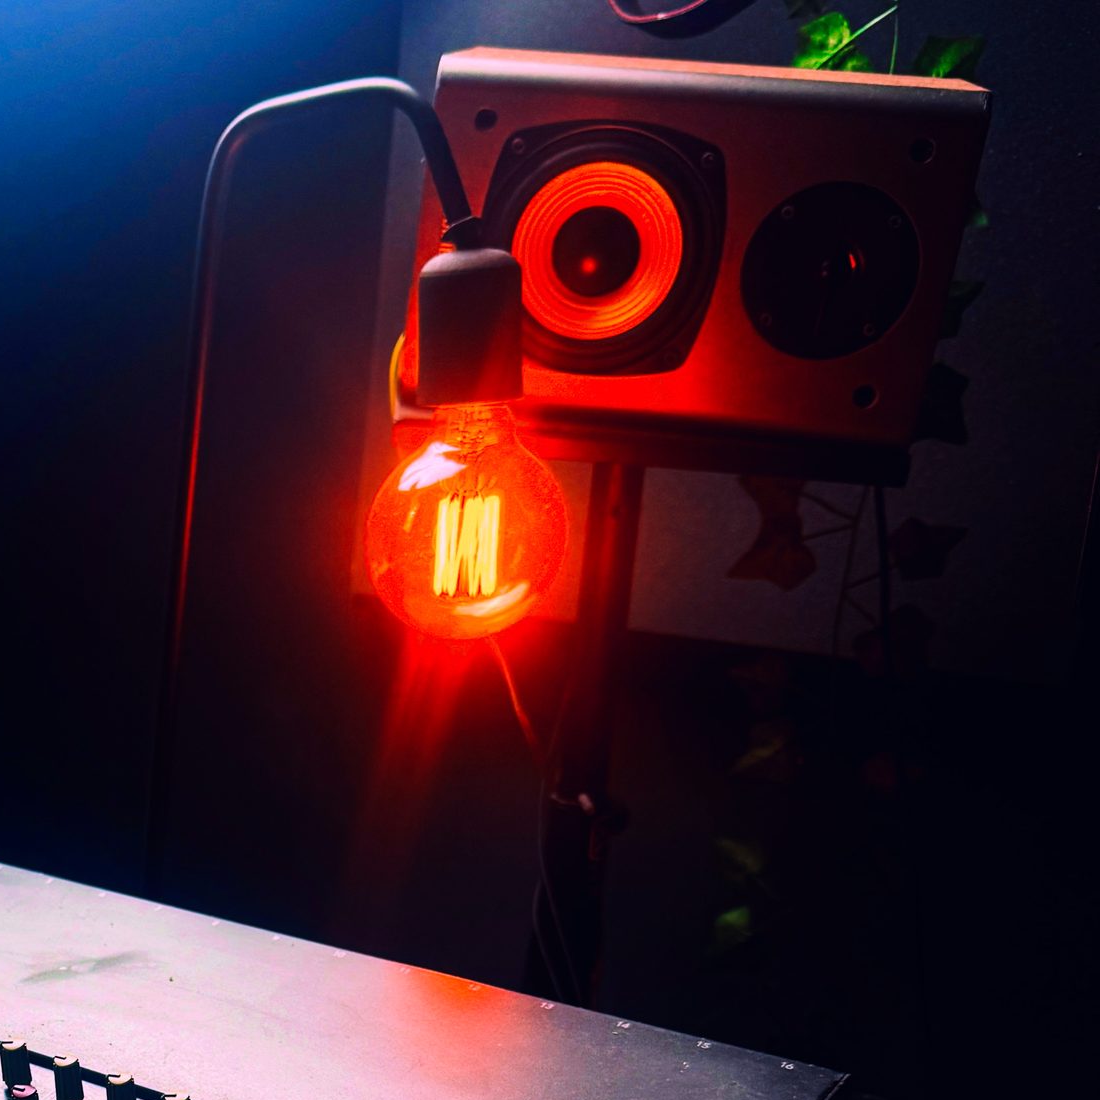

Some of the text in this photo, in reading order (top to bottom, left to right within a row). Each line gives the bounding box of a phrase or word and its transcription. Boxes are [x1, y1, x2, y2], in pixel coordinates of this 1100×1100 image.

[540, 1001, 555, 1011] 13
[616, 1020, 631, 1030] 14
[696, 1039, 712, 1050] 15
[780, 1060, 794, 1071] 16
